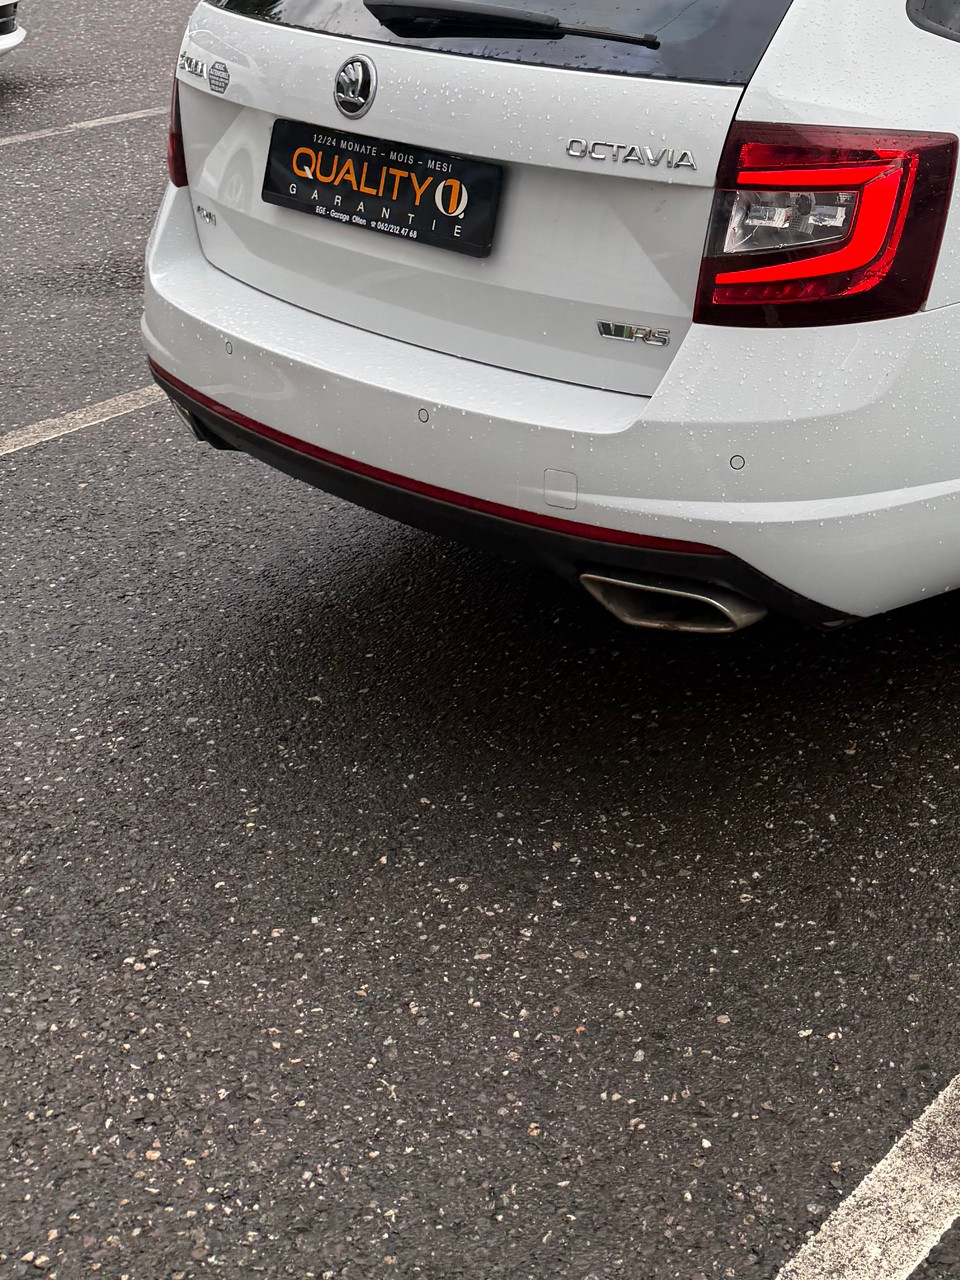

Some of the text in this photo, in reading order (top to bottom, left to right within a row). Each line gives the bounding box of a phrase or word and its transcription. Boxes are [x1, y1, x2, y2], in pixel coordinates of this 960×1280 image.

[313, 134, 336, 148] 12/24
[340, 141, 377, 156] MONATE
[389, 151, 414, 165] MOIS
[427, 159, 452, 173] MESI
[566, 137, 698, 170] OCTAVIA
[292, 147, 433, 206] QUALITY
[289, 184, 462, 237] GARANTIE
[330, 209, 350, 222] Garage
[377, 221, 400, 234] 062/212
[400, 227, 408, 236] 47
